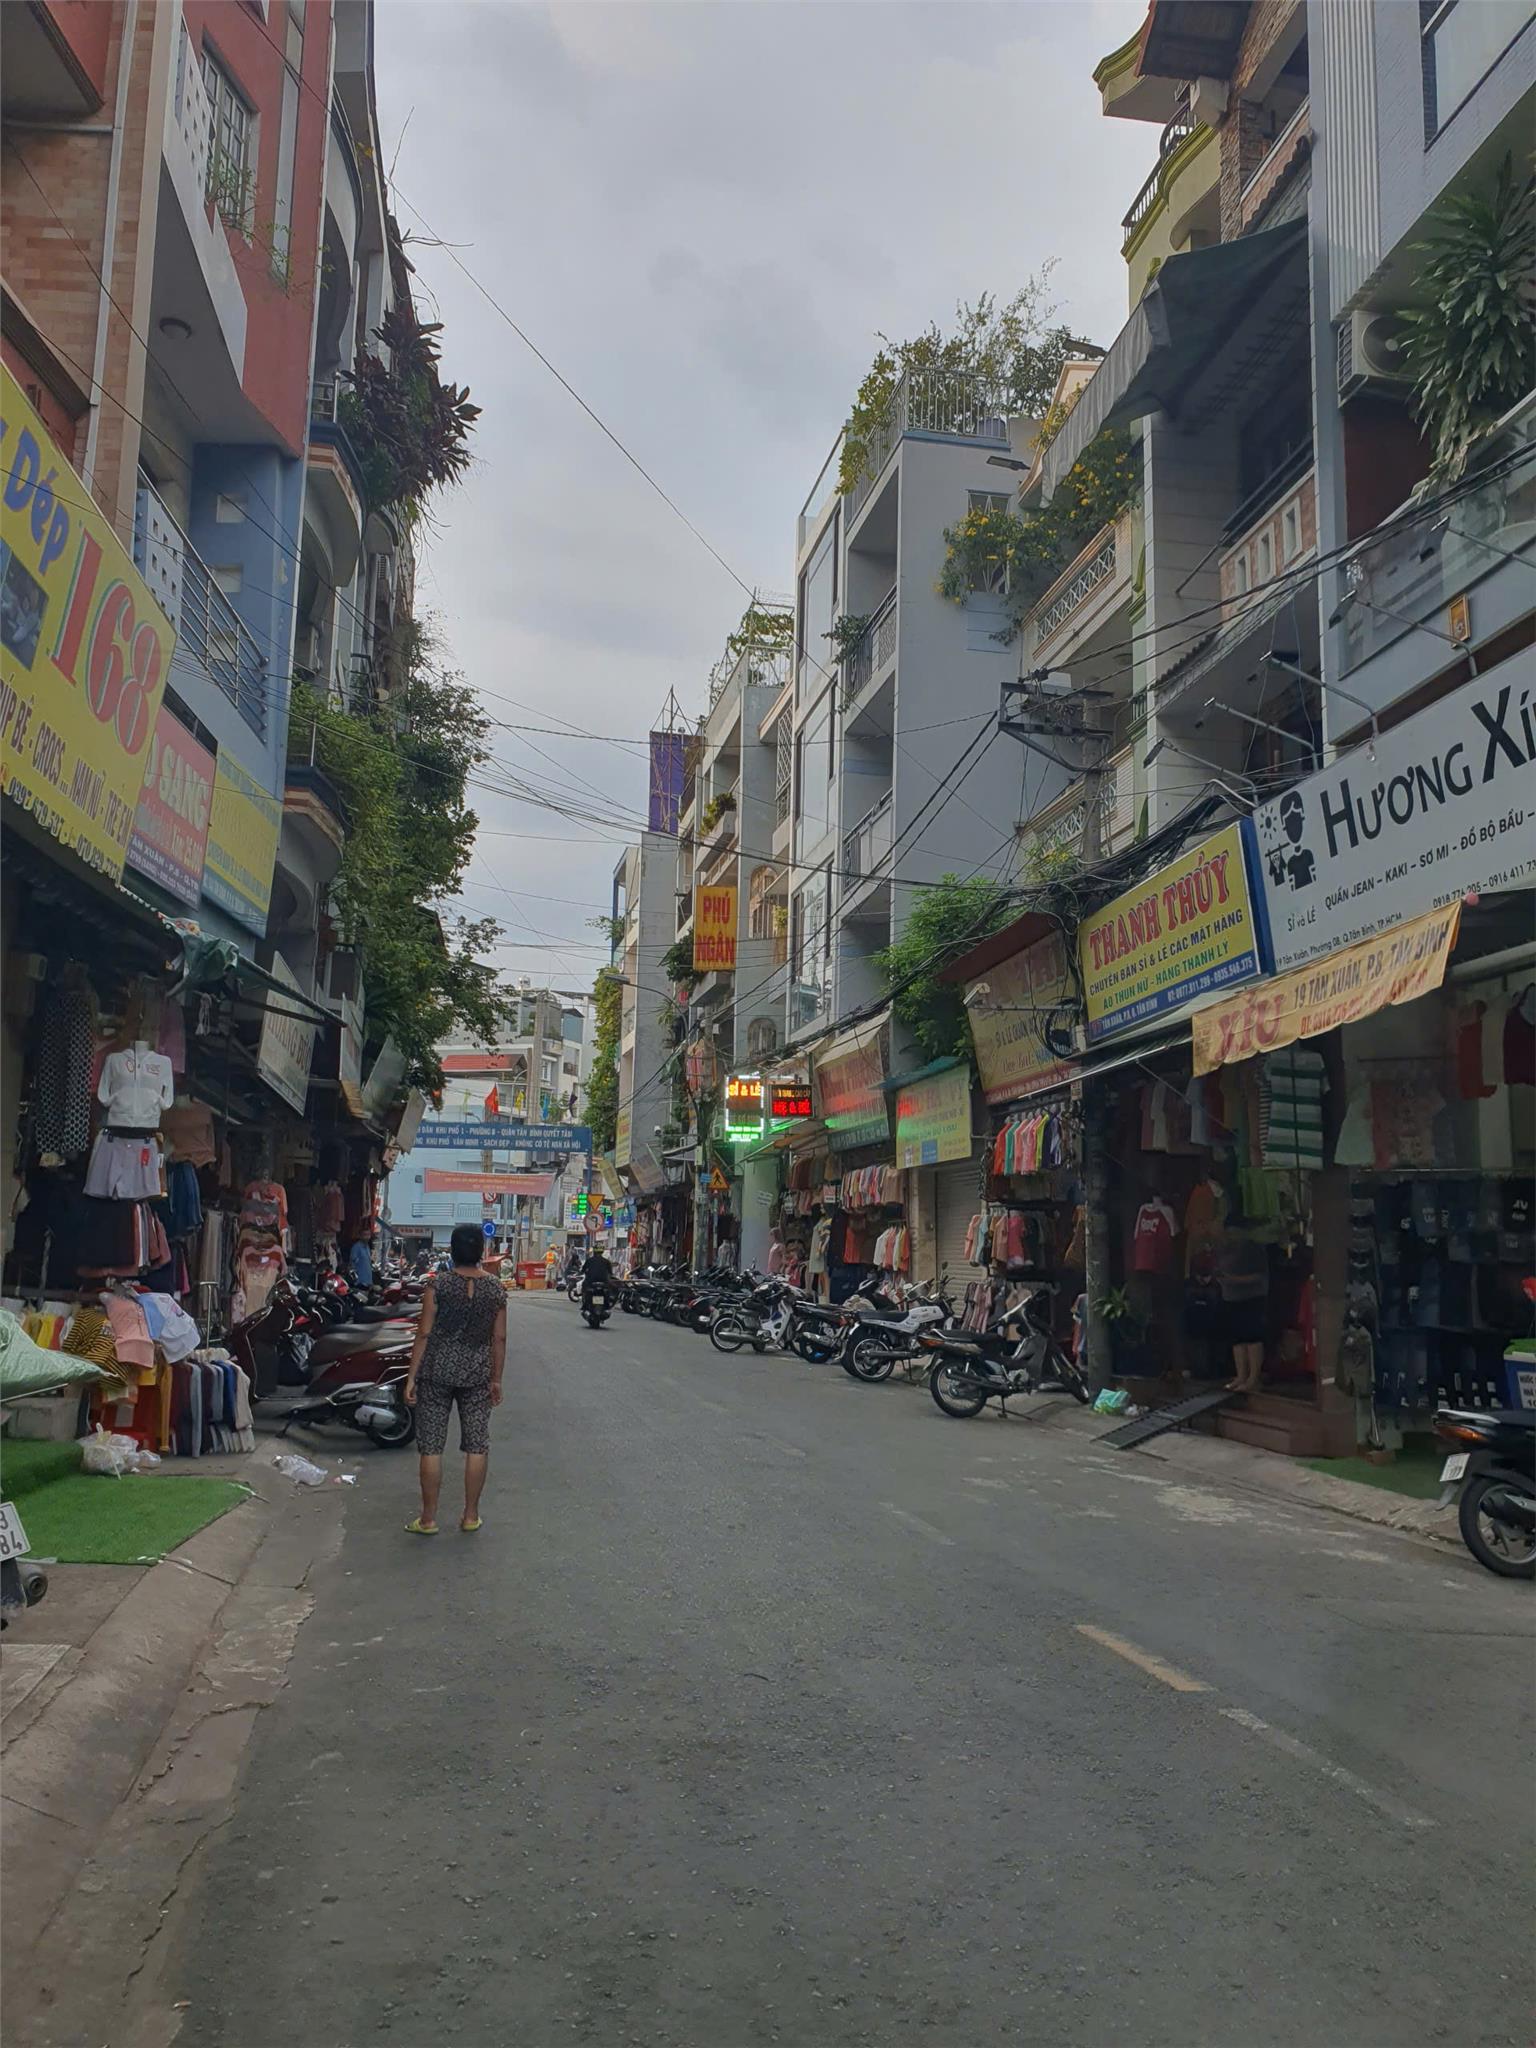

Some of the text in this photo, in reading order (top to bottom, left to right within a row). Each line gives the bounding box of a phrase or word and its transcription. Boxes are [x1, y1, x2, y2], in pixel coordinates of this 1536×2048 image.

[48, 526, 161, 756] 168
[159, 743, 210, 832] SANG
[1319, 742, 1473, 858] HƯƠNG
[1351, 876, 1374, 898] JEAN
[1385, 862, 1408, 884] KAKI
[1419, 850, 1434, 870] SƠ
[1436, 843, 1450, 864] MI
[1479, 819, 1496, 843] BỘ
[1489, 870, 1508, 889] 0916
[1510, 864, 1525, 881] 411
[703, 890, 731, 925] PHÚ
[695, 930, 736, 965] NGÂN
[1089, 893, 1162, 972] THANH
[1149, 953, 1156, 966] &
[1214, 908, 1243, 936] HÀNG
[1114, 985, 1136, 1006] THUN
[1156, 967, 1181, 987] HÀNG
[1182, 951, 1215, 974] THANH
[1294, 982, 1306, 1009] 19
[740, 1084, 749, 1097] &
[788, 1101, 798, 1114] &
[436, 1126, 448, 1134] KHU
